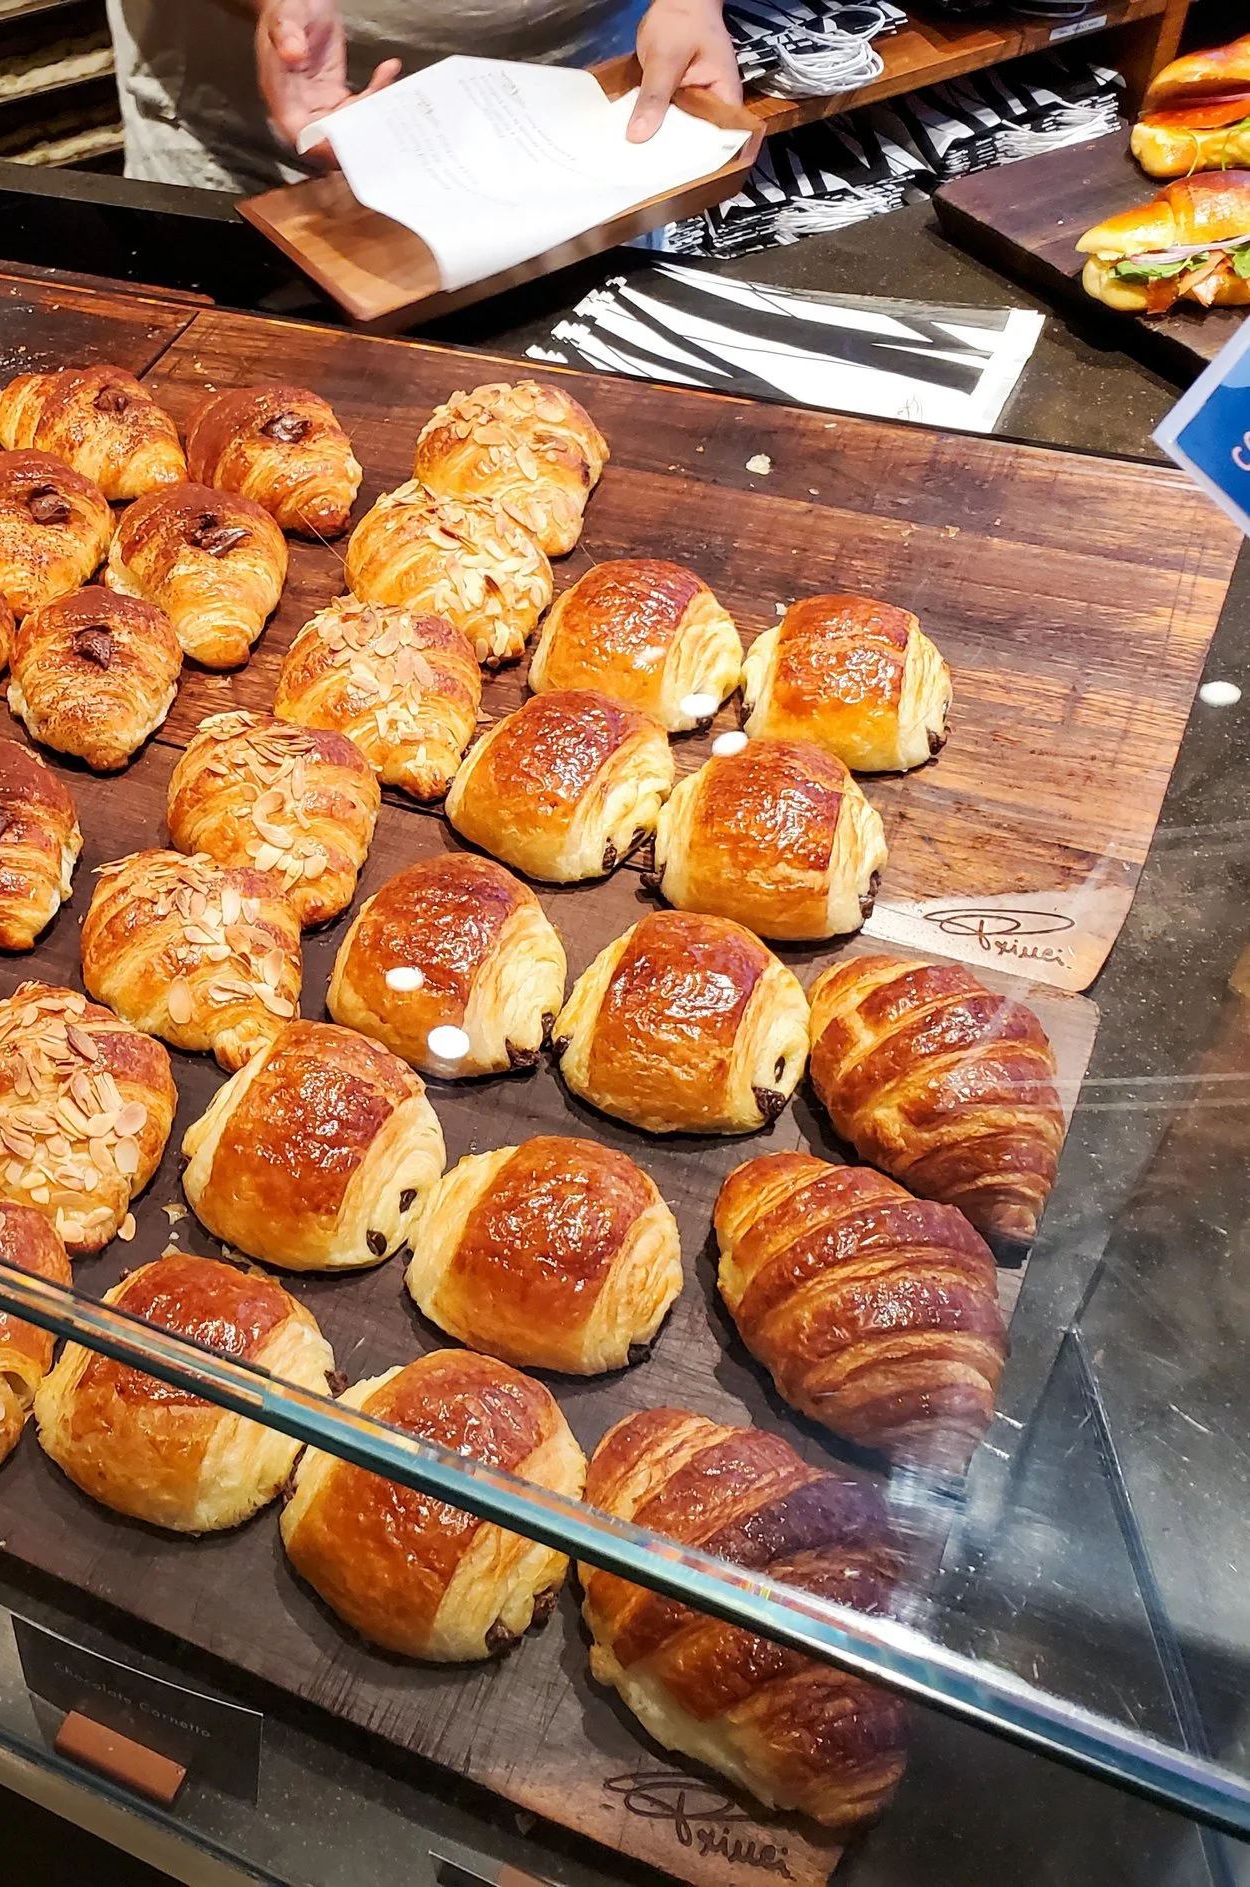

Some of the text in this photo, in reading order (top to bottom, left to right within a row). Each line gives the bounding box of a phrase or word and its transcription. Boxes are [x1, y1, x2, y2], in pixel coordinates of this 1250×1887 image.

[923, 908, 1075, 970] Princi
[139, 1702, 212, 1738] Cornetto
[603, 1771, 797, 1881] Princi
